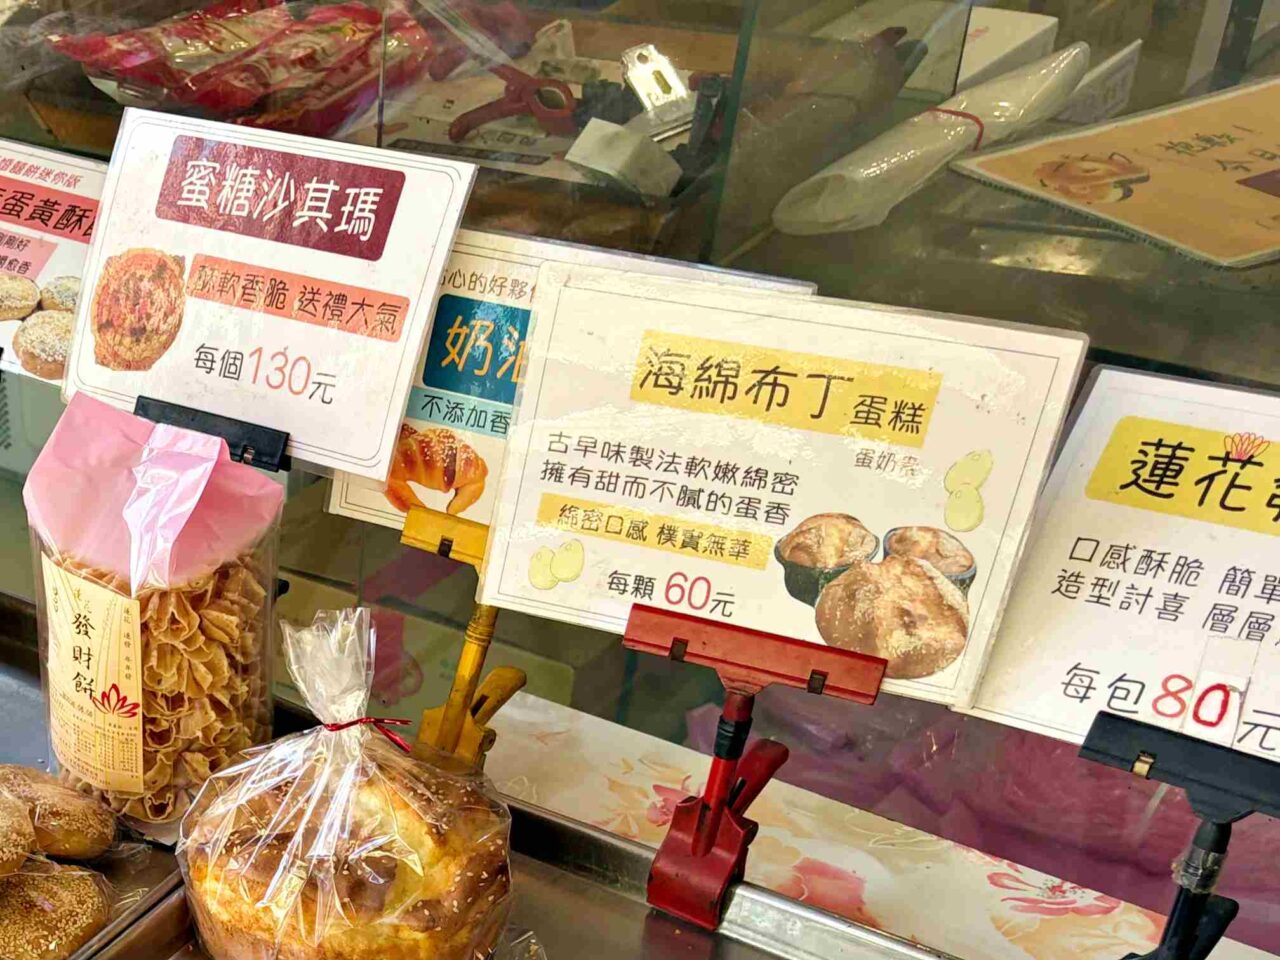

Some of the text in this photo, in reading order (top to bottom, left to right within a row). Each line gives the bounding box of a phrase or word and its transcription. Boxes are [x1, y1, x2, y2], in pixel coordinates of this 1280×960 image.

[176, 158, 384, 242] 蜜糖沙其瑪
[192, 264, 408, 336] 酥軟香脆 送禮大氣
[441, 268, 537, 303] 心的好夥
[194, 344, 338, 405] 每個130元
[421, 393, 511, 435] 不添加香
[539, 459, 791, 527] 擁有甜而不膩的蛋香
[546, 431, 800, 497] 古早味製法軟嫩綿密
[655, 519, 753, 561] 樸實無華
[1068, 537, 1205, 588] 口感酥脆
[1051, 569, 1280, 649] 造型討喜 層層
[72, 613, 96, 700] 發財餅
[1060, 662, 1280, 752] 每包80元
